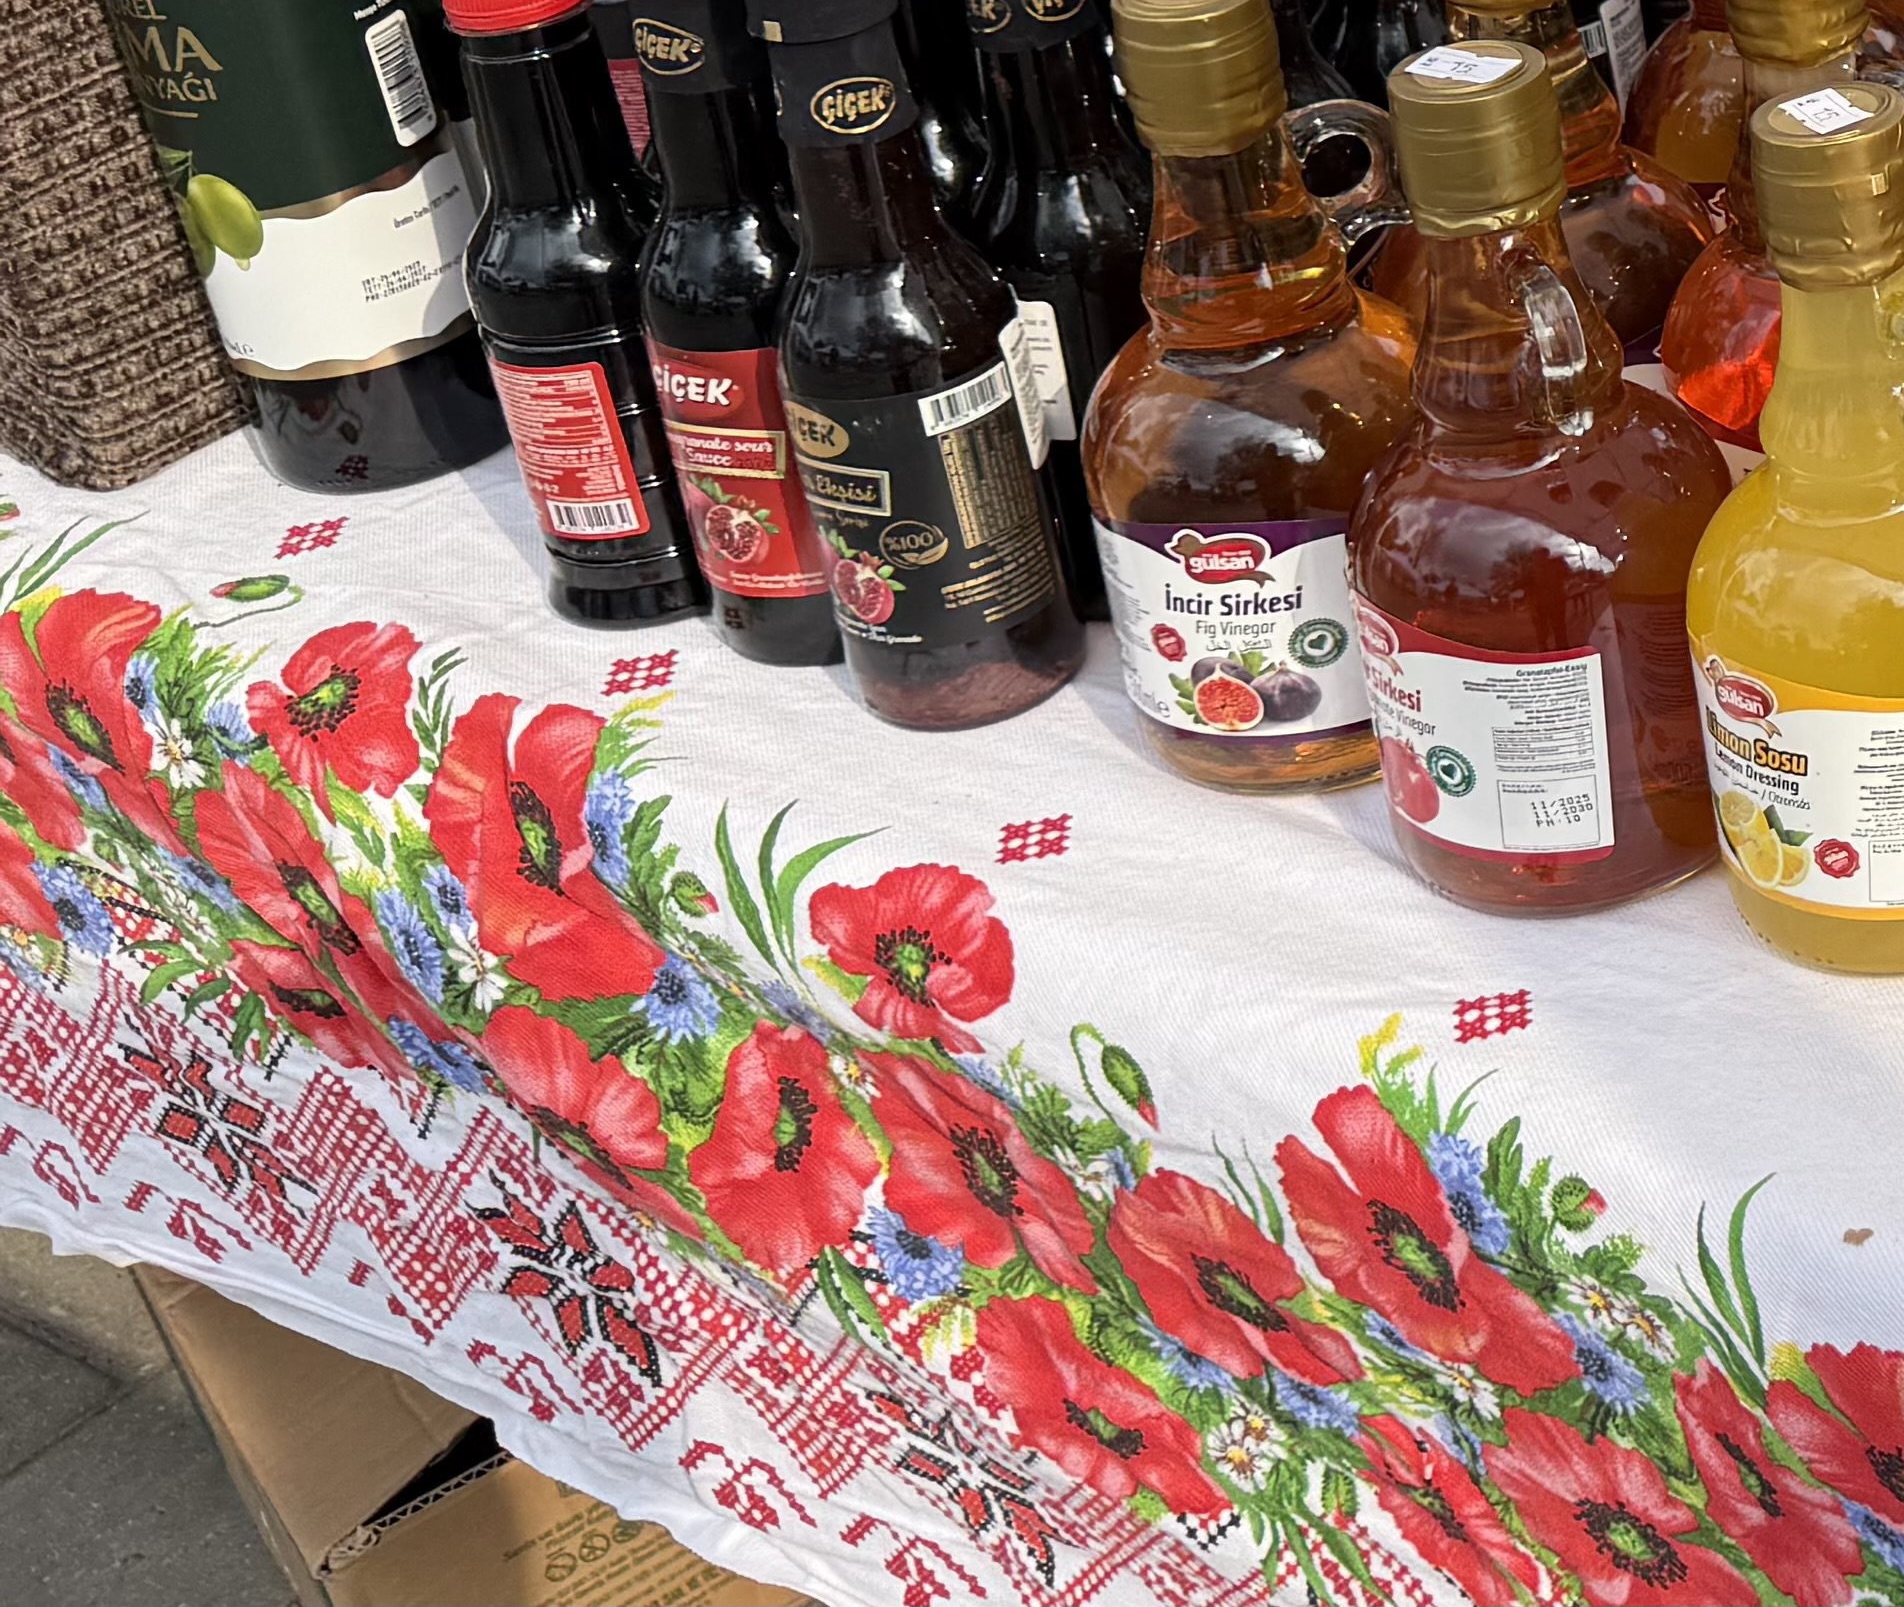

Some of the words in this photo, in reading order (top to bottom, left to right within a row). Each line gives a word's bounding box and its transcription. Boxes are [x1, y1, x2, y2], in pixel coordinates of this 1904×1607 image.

[819, 86, 888, 125] ÇİÇEK
[796, 414, 836, 447] ÇEK
[1189, 550, 1256, 575] gülsan
[1165, 584, 1214, 616] İncir
[1219, 586, 1303, 616] Sirkesi
[1195, 622, 1217, 639] Fig
[1220, 621, 1277, 639] Vinegar
[1717, 683, 1765, 717] gülsan
[1706, 706, 1752, 762] Limon
[1754, 737, 1809, 776] Sosu
[1715, 745, 1744, 775] Lemon
[1746, 763, 1799, 796] Dressing
[1530, 794, 1591, 811] 11/2025
